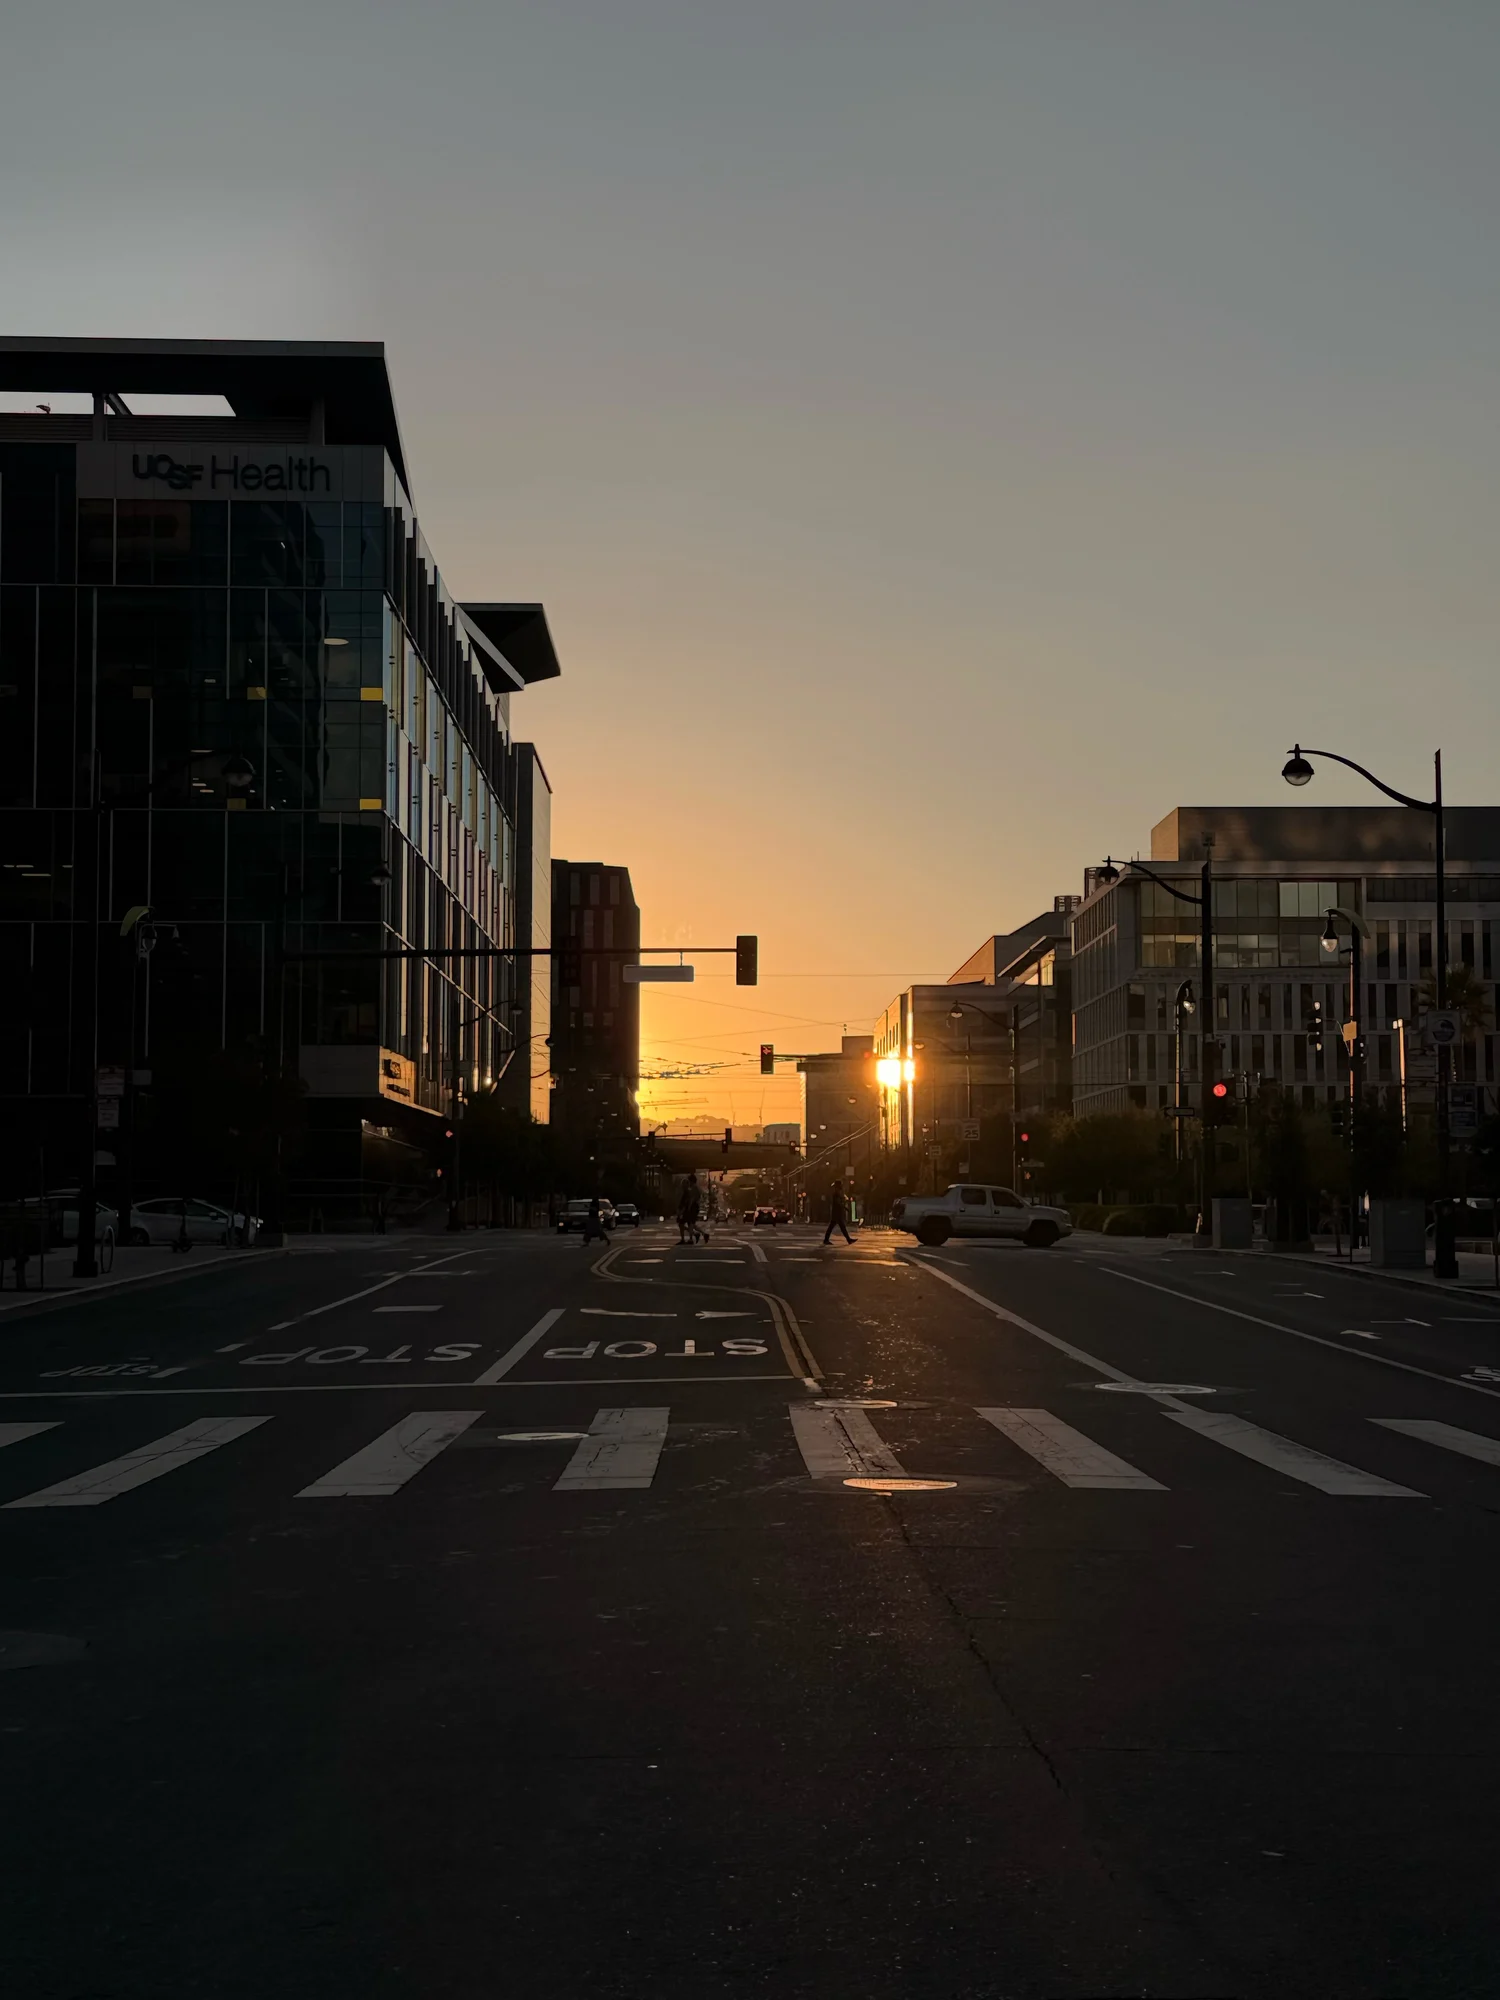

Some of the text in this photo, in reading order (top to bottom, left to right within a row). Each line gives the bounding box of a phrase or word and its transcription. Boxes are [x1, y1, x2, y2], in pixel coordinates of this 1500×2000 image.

[132, 454, 330, 492] UCSF Health
[964, 1129, 979, 1139] 25
[238, 1343, 483, 1365] STOP
[543, 1338, 769, 1359] STOP
[40, 1364, 159, 1378] STOP
